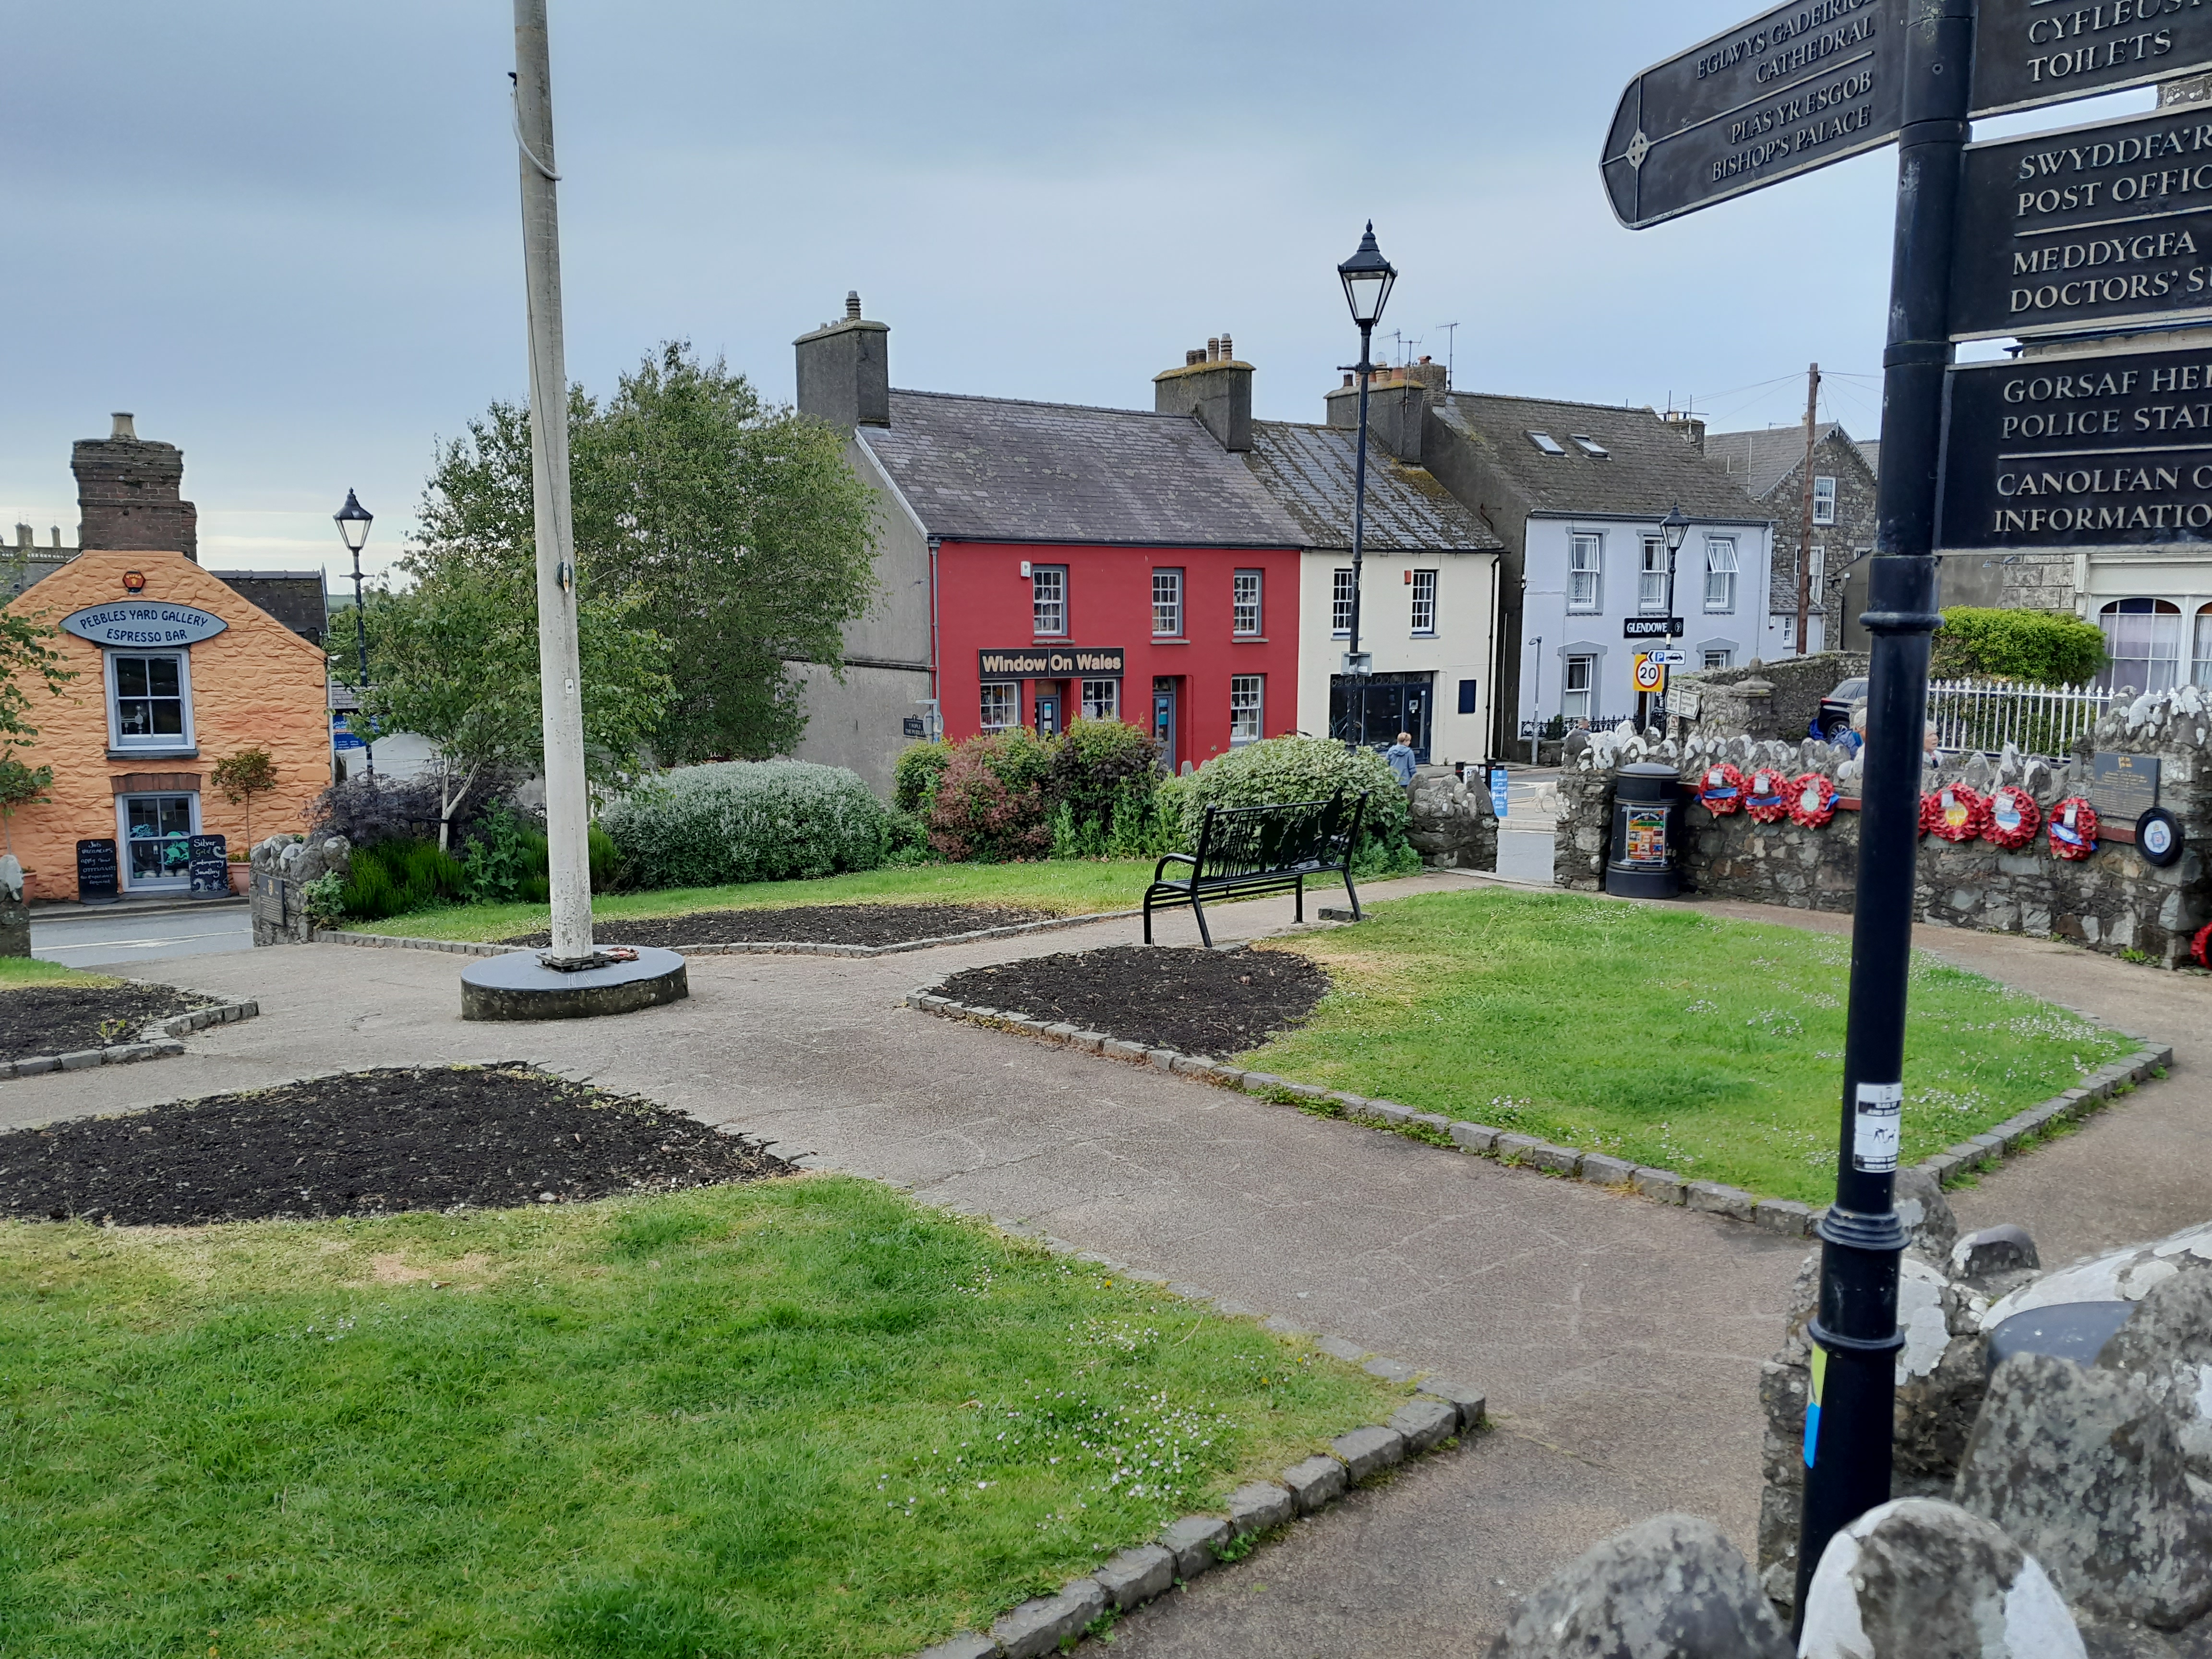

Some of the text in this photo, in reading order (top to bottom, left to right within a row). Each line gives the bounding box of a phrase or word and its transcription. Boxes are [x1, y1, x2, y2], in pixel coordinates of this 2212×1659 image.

[1697, 0, 1873, 79] EGLWYS GADEIRI
[1756, 16, 1875, 83] CATHEDRAL
[2027, 28, 2172, 83] TOILETS
[1731, 70, 1872, 144] PLÂS YR ESGOB
[1712, 104, 1871, 182] BISHOP'S PALACE
[2017, 181, 2103, 217] POST
[2013, 230, 2198, 276] MEDDYGFA
[2010, 265, 2212, 313] DOCTORS' S
[2003, 364, 2212, 404] GORSAF HE
[2001, 409, 2121, 440] POLICE
[1996, 467, 2181, 497] CANOLFAN
[80, 609, 208, 630] PEBBLES YARD GALLERY
[107, 628, 188, 642] ESPRESSO BAR
[1626, 622, 1672, 633] GLENDOWE
[982, 653, 1121, 672] Window On Wales
[1640, 667, 1657, 680] 20
[1657, 653, 1663, 661] P
[193, 838, 216, 848] Silver
